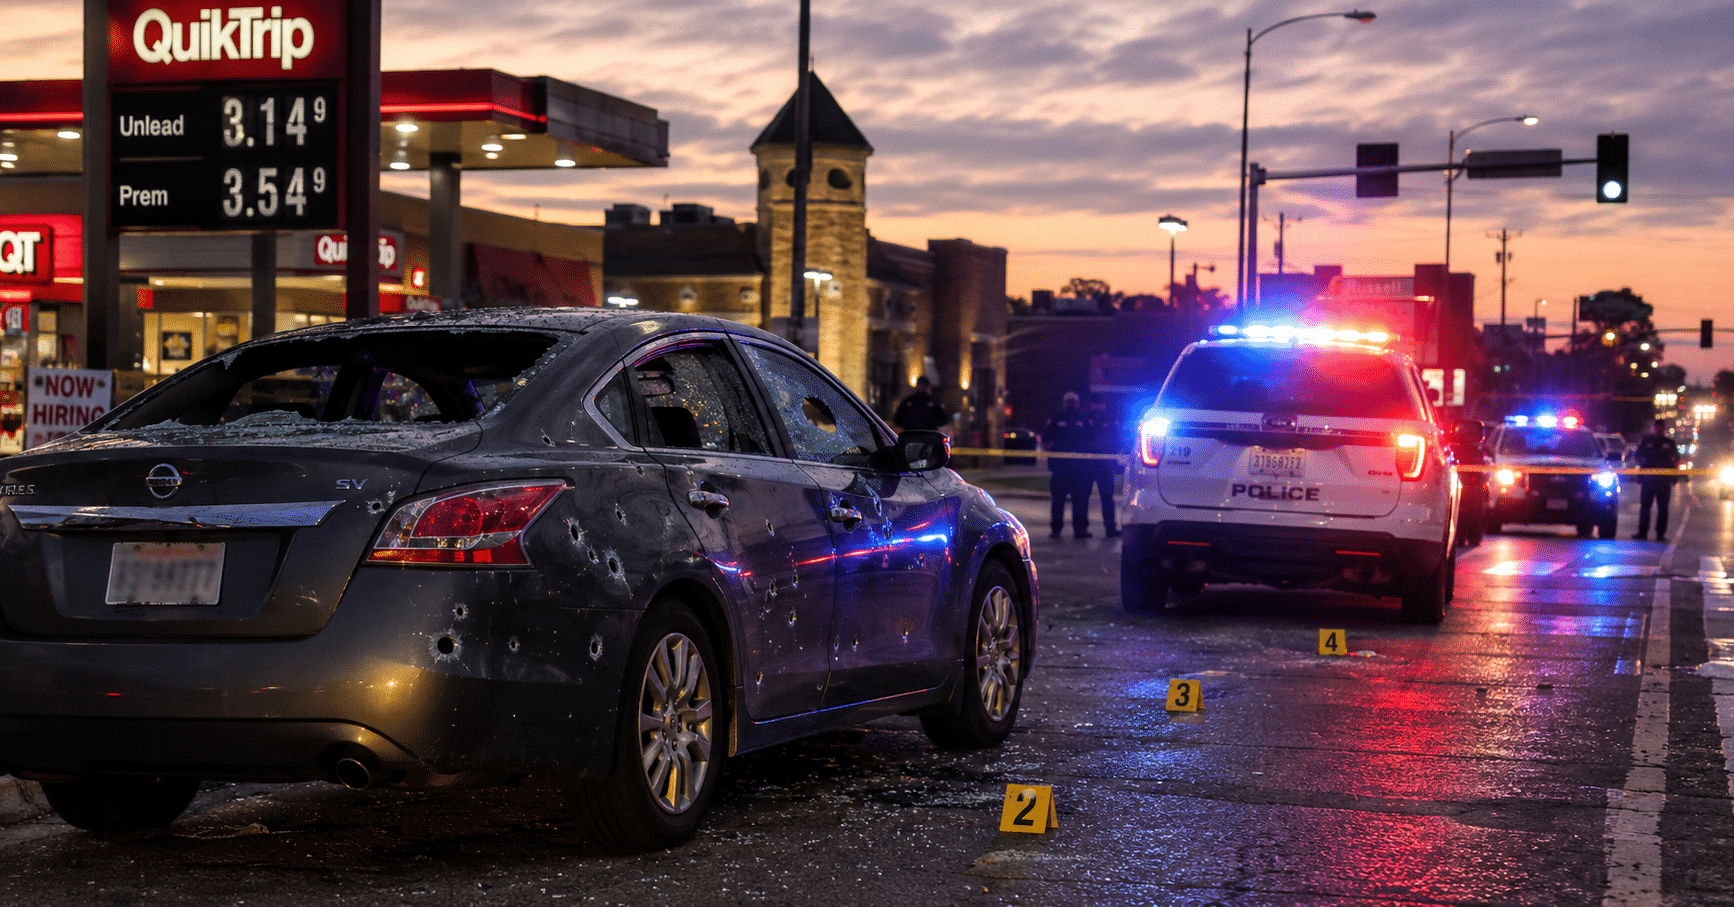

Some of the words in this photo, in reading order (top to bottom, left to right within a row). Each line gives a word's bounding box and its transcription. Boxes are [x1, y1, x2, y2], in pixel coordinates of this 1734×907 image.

[133, 6, 314, 70] QuikTrip
[120, 114, 184, 137] Unlead
[120, 185, 168, 206] Prem
[0, 230, 41, 274] QT
[45, 375, 95, 398] NOW
[336, 479, 368, 489] SV
[1324, 632, 1338, 651] 4
[1174, 683, 1190, 706] 3
[1013, 790, 1037, 826] 2
